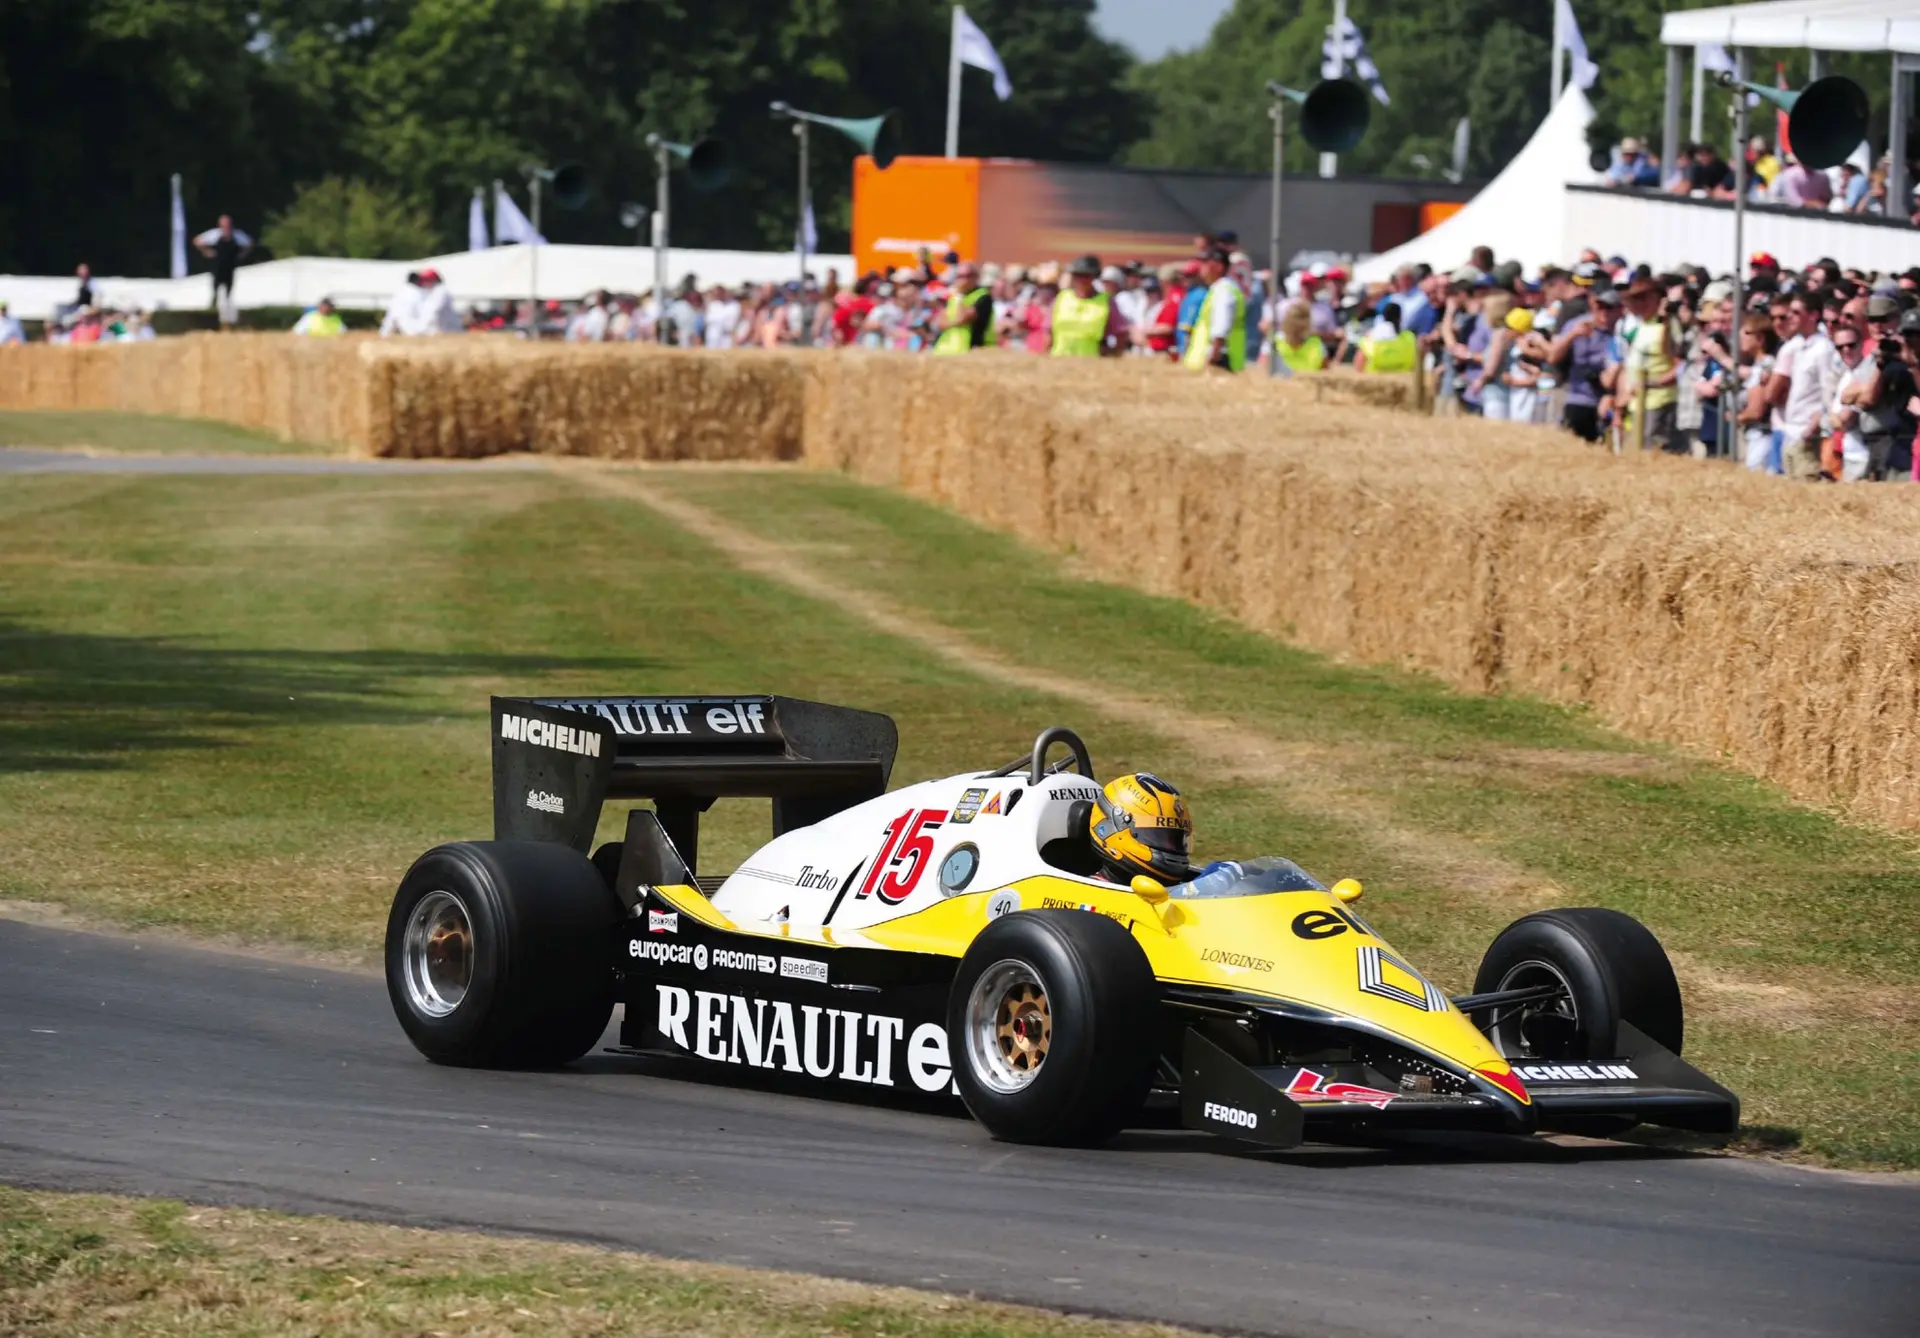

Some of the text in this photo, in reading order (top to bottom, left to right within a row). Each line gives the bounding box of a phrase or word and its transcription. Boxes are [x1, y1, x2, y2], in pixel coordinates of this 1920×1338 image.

[706, 704, 765, 734] elf
[501, 713, 601, 758] MICHELIN
[539, 791, 564, 806] Carbon
[855, 808, 948, 906] 15
[794, 865, 839, 892] Turbo
[995, 899, 1011, 915] 40
[1041, 897, 1076, 910] PROST
[650, 915, 677, 928] CHAMPION
[1291, 906, 1379, 940] el
[629, 938, 692, 966] europcar
[712, 948, 756, 972] FACOM
[1200, 948, 1275, 973] LONGINES
[782, 960, 826, 979] speedline
[655, 984, 904, 1087] RENAULT
[1511, 1065, 1639, 1080] ICHELIN
[1203, 1101, 1258, 1129] FERODO
